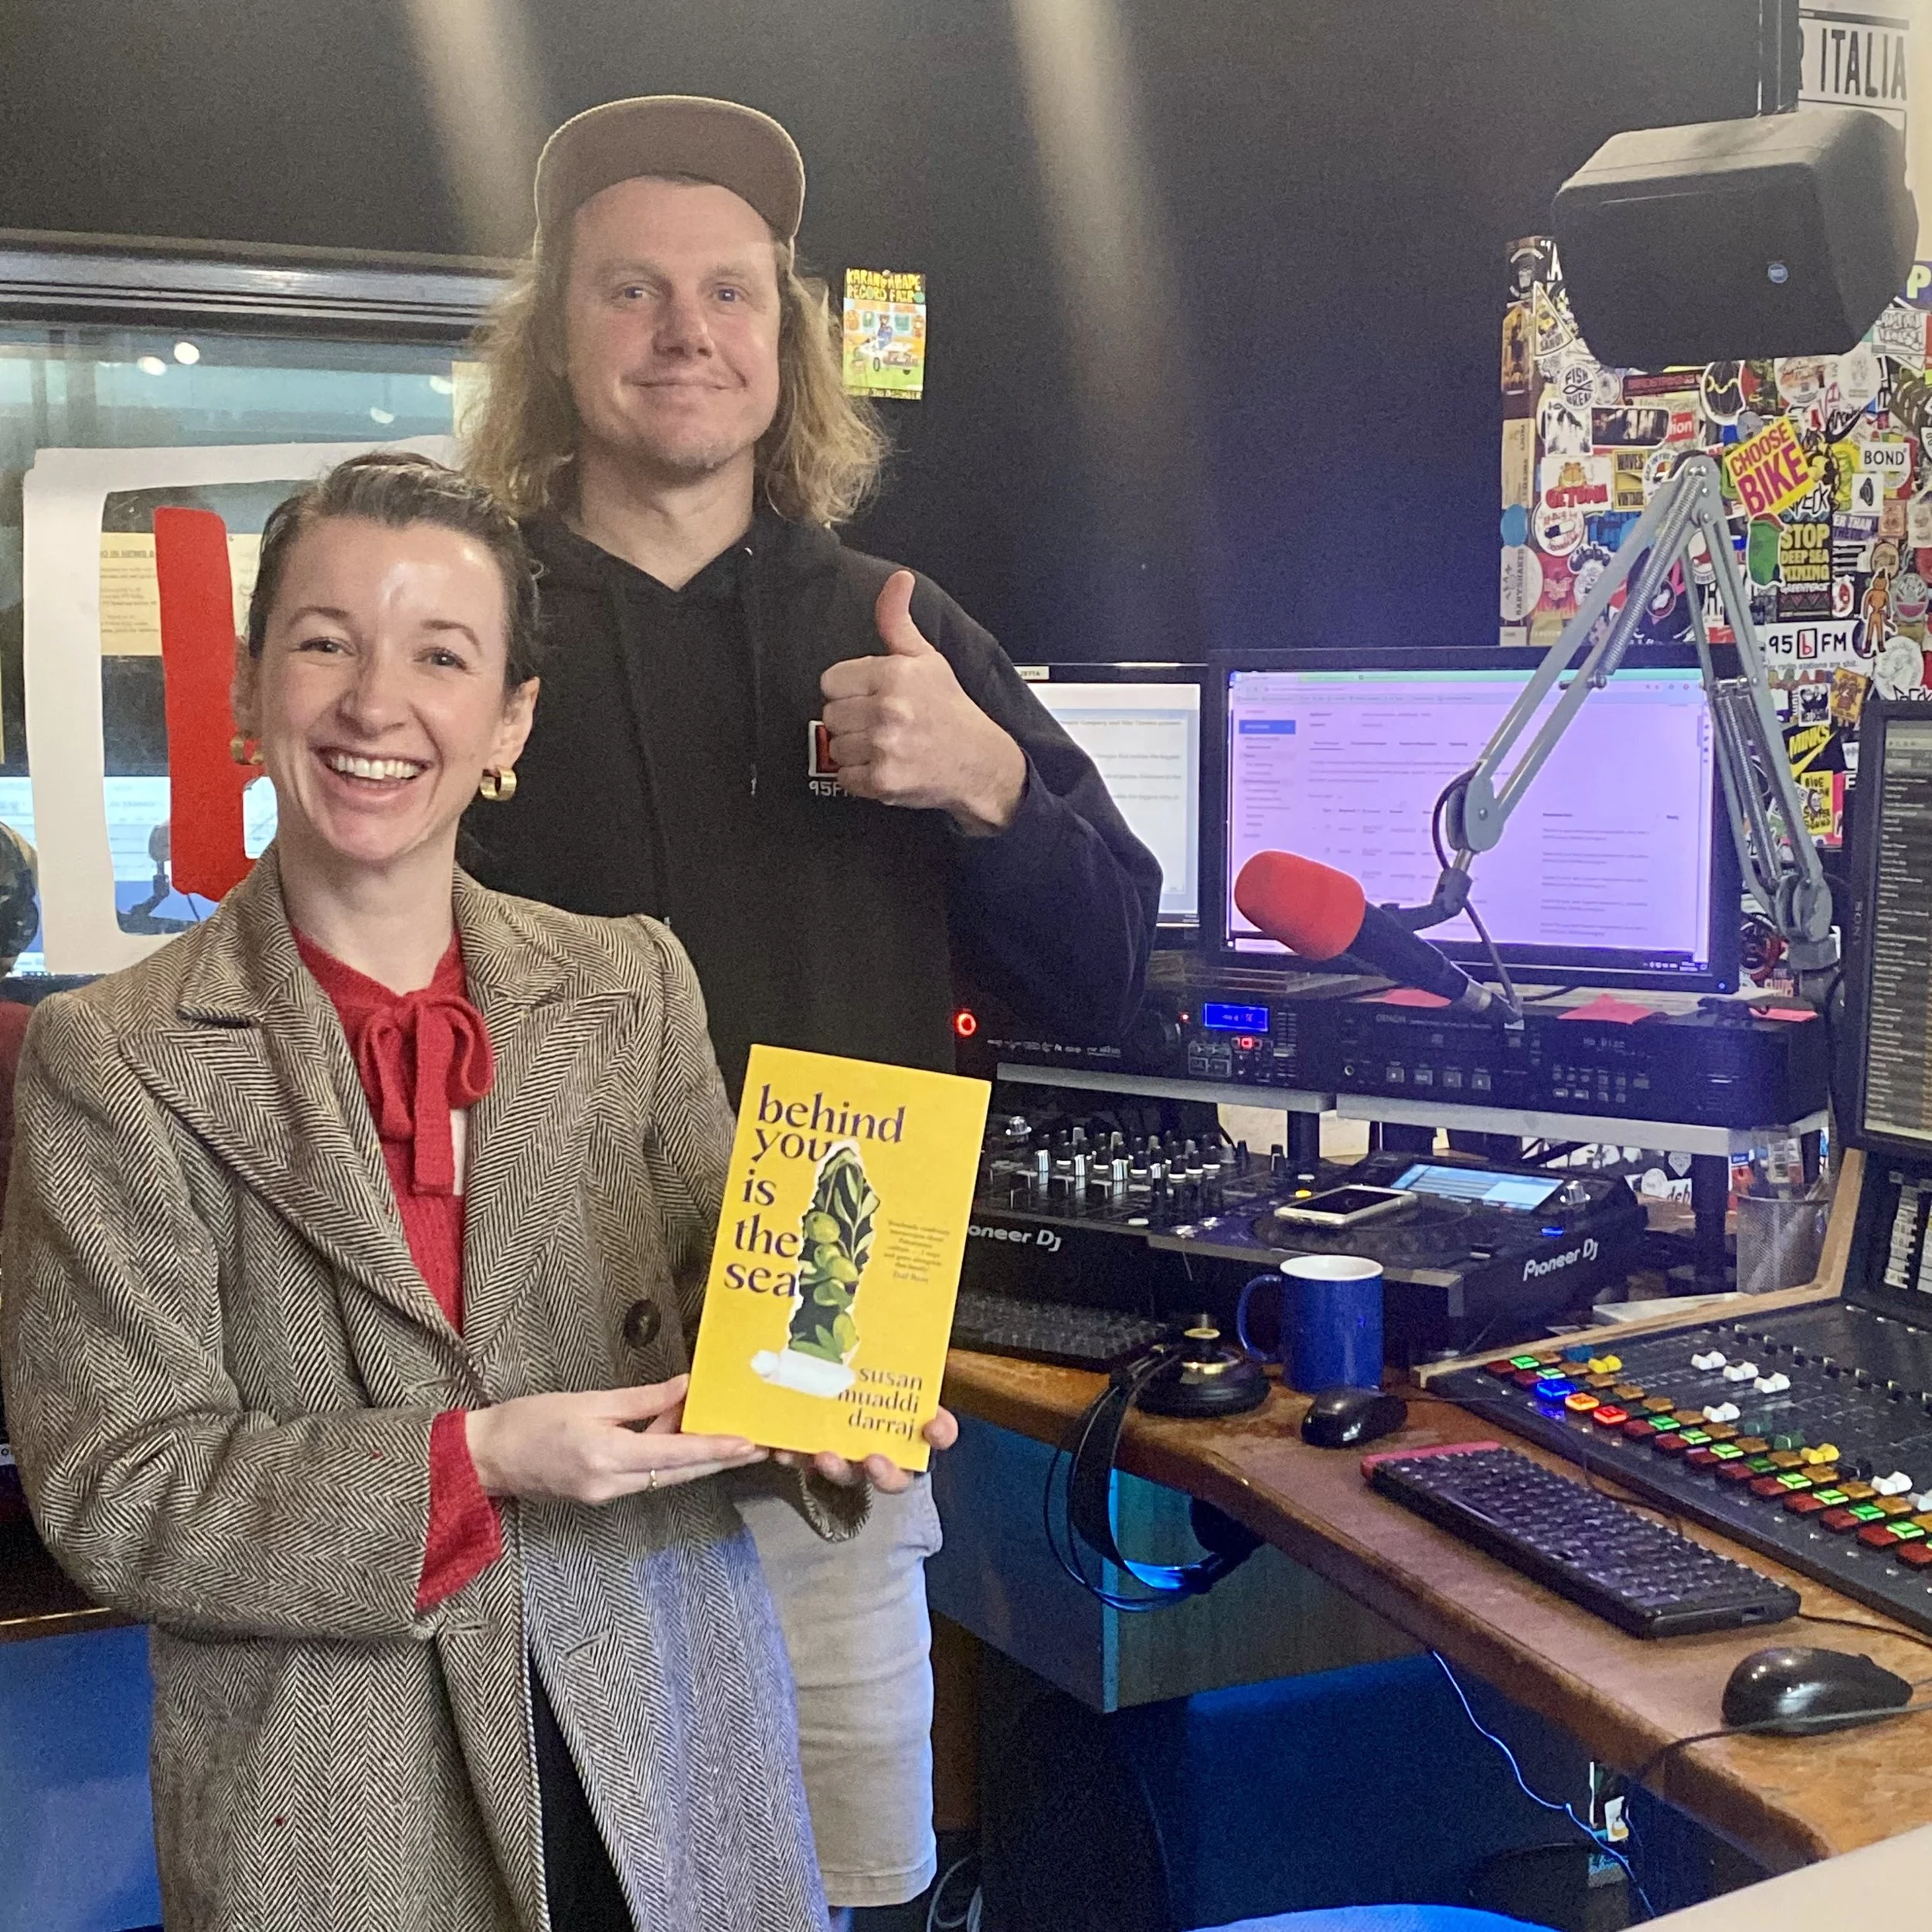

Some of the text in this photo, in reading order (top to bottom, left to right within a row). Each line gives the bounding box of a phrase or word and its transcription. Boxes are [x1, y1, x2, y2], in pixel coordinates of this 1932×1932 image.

[1820, 28, 1907, 101] ITALIA
[847, 284, 914, 303] RECORD FAIR
[1565, 367, 1588, 385] FISH
[1730, 422, 1791, 476] CHOOSE
[1864, 451, 1904, 465] BOND
[1737, 442, 1809, 515] BIKE
[1781, 522, 1831, 549] STOP
[1781, 549, 1829, 564] DEEP SEA
[1769, 635, 1793, 654] 95
[1821, 632, 1846, 652] FM
[1789, 724, 1830, 760] MINKS
[809, 781, 848, 797] 95F
[757, 1083, 906, 1143] behind
[751, 1128, 832, 1163] you
[742, 1168, 777, 1206] is
[735, 1213, 798, 1258] the
[968, 1225, 1061, 1252] oneer DJ
[1522, 1238, 1599, 1281] Pioneer DJ
[723, 1263, 797, 1298] sea
[859, 1367, 923, 1392] susan
[838, 1389, 919, 1413] muaddi
[849, 1407, 915, 1441] darraj
